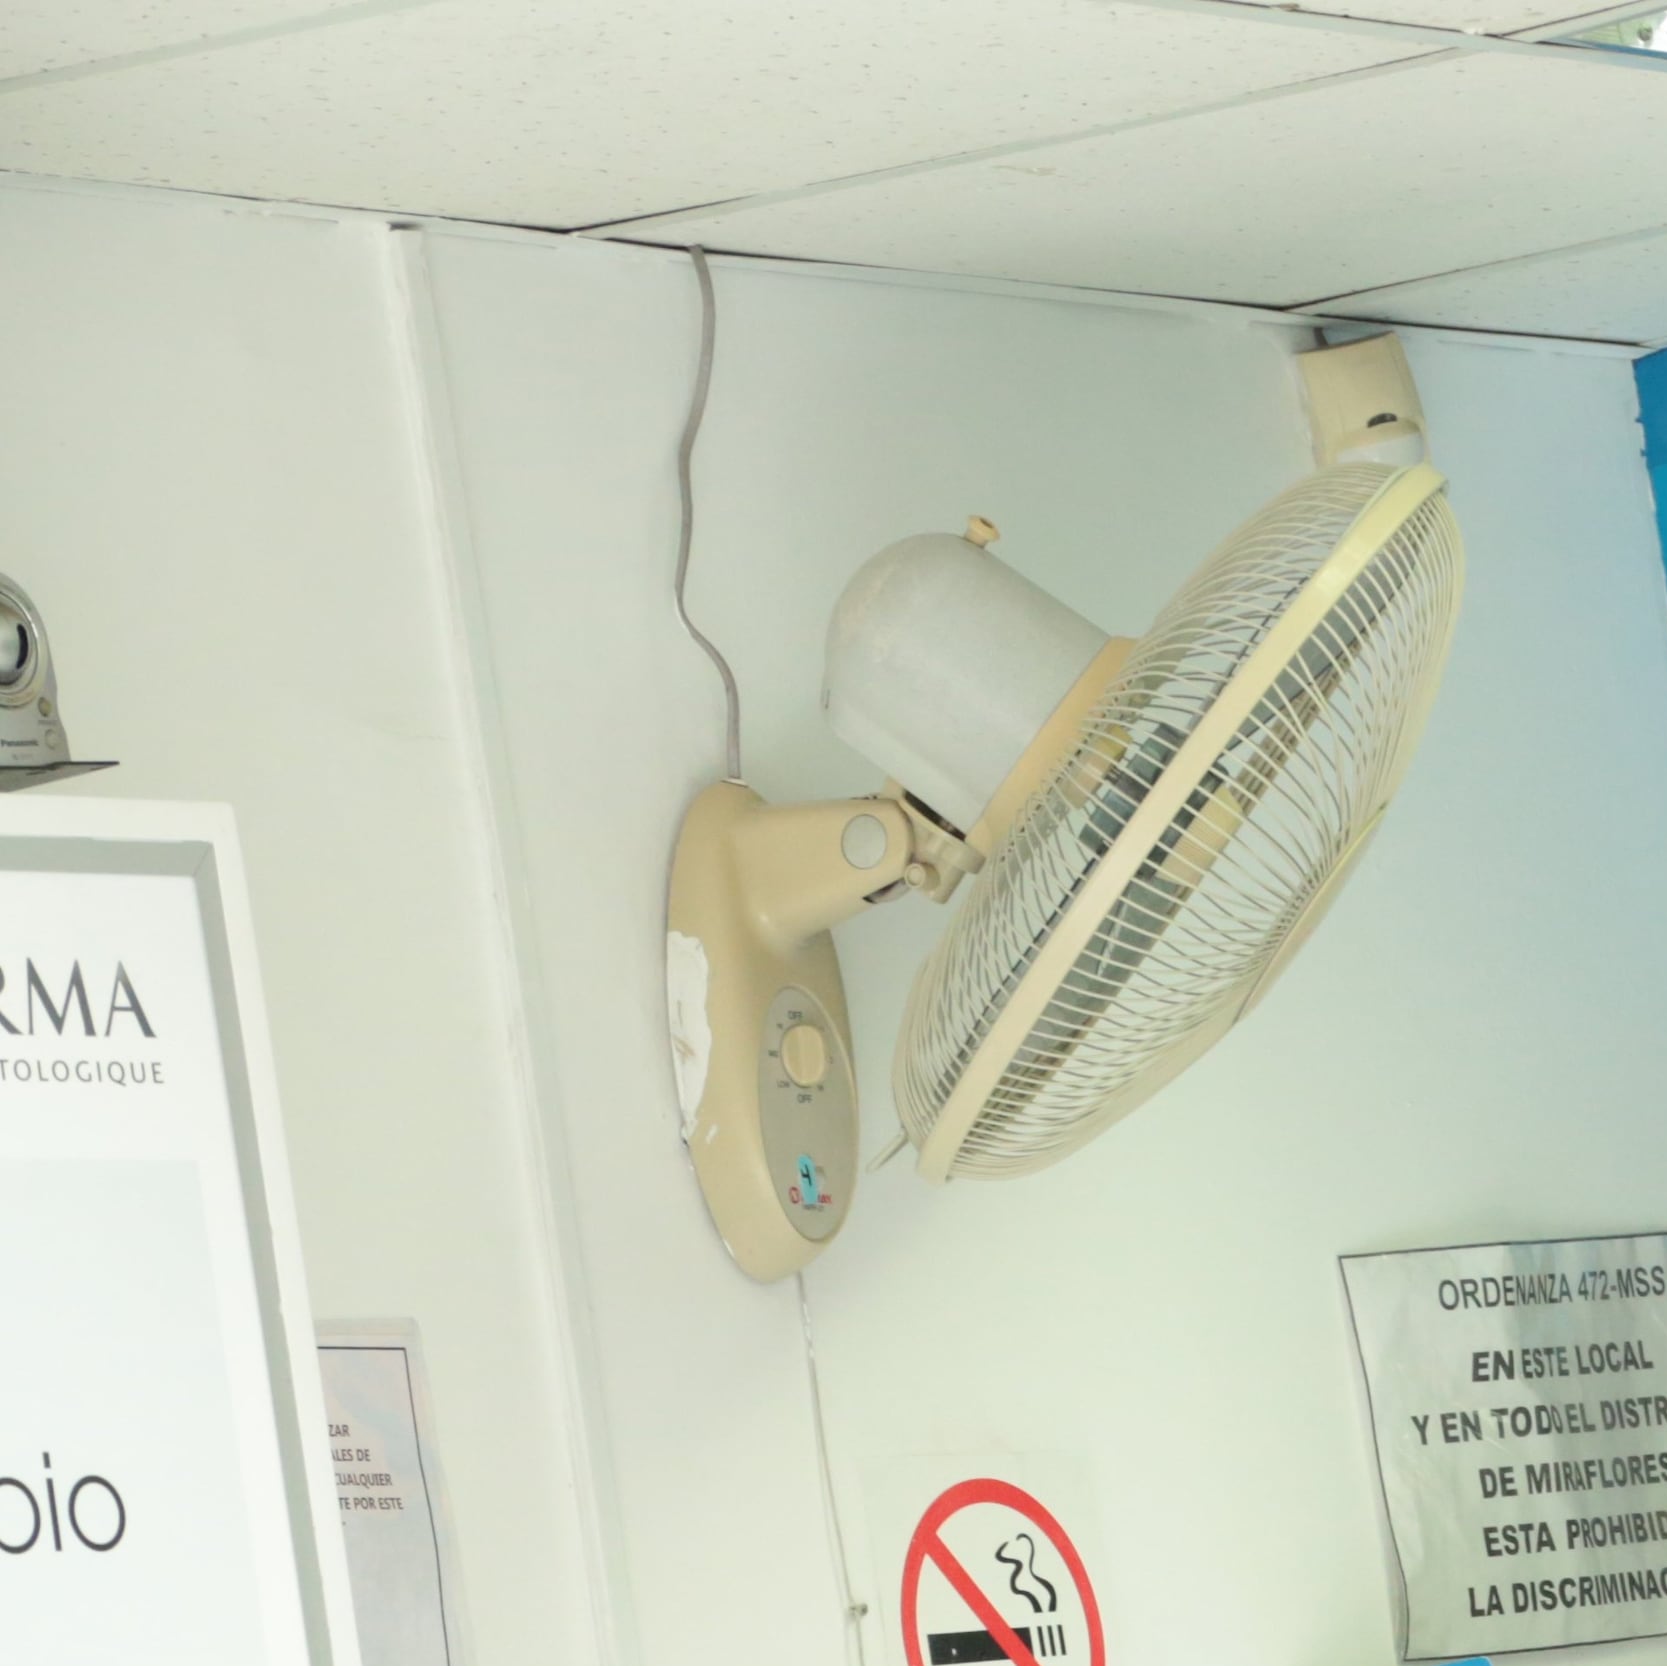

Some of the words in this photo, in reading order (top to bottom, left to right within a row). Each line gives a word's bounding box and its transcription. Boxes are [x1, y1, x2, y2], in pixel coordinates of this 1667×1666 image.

[1438, 1273, 1573, 1310] ORDENANZA
[1577, 1265, 1666, 1302] 472-MSS
[1471, 1350, 1515, 1382] EN
[1521, 1346, 1570, 1378] ESTE
[1576, 1339, 1654, 1375] LOCAL
[1411, 1414, 1429, 1445] Y
[1440, 1411, 1483, 1443] EN
[1491, 1404, 1564, 1439] TODO
[1567, 1402, 1596, 1433] EL
[1479, 1466, 1518, 1499] DE
[1483, 1522, 1556, 1557] ESTA
[1468, 1585, 1504, 1618] LA
